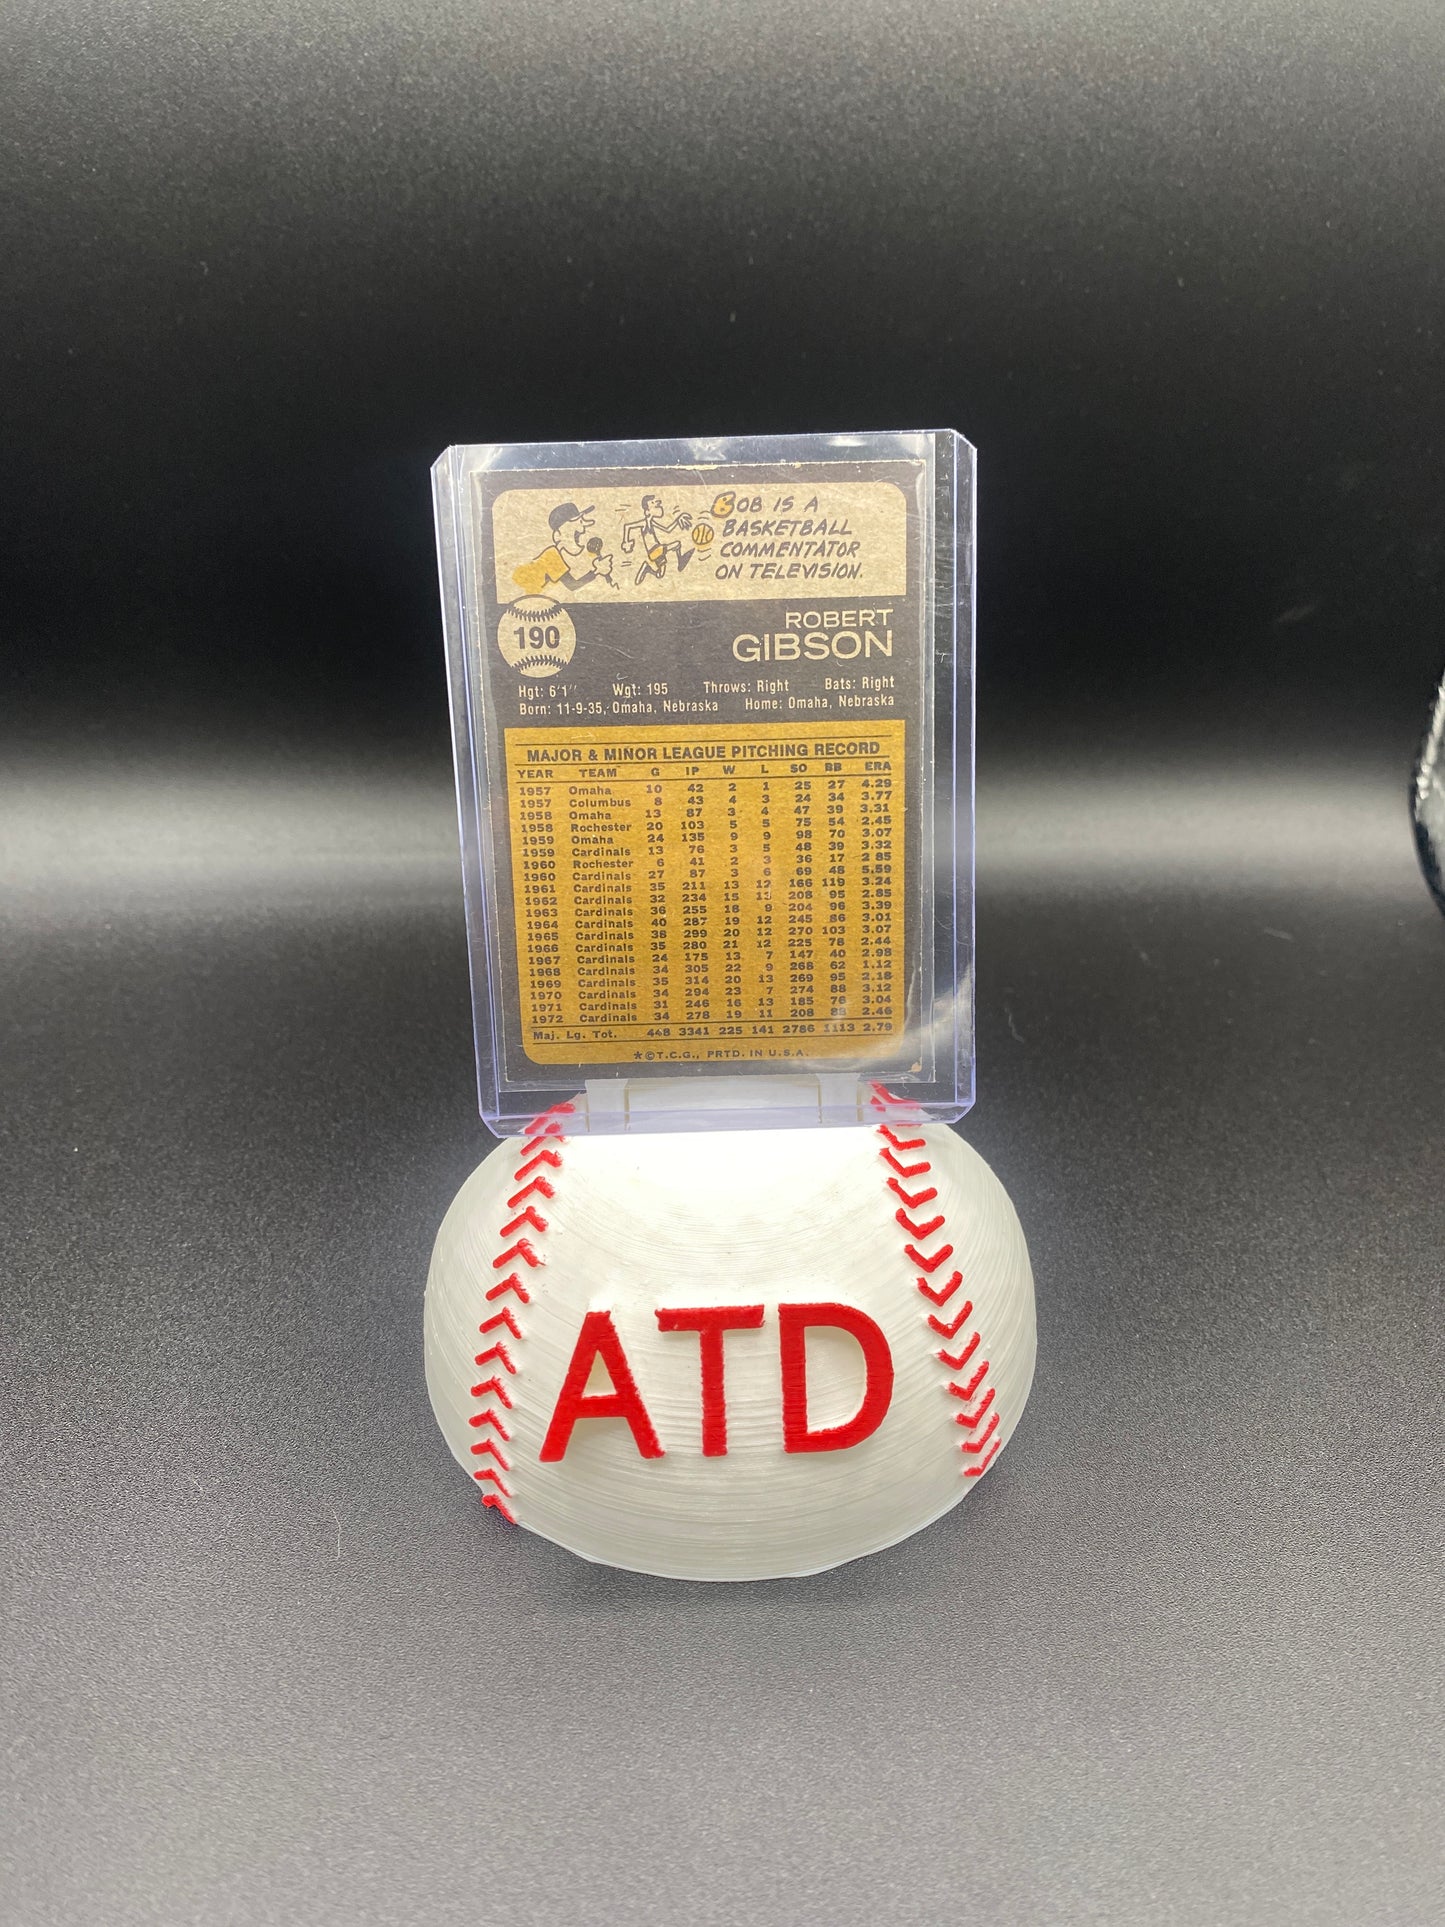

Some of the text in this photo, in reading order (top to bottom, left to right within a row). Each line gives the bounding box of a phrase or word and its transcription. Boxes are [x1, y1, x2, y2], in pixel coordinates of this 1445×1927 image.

[710, 491, 818, 518] BOB IS A
[723, 518, 852, 537] BASKETBALL
[720, 540, 860, 558] COMMENTATOR
[715, 562, 863, 580] ON TELEVISION.
[785, 608, 894, 629] ROBERT
[514, 626, 560, 650] 190
[732, 630, 893, 662] GIBSON
[519, 685, 544, 700] Hgt:
[612, 683, 641, 698] Wgt:
[647, 683, 668, 695] 195
[703, 681, 751, 693] Throws:
[757, 679, 789, 694] Right
[825, 678, 856, 690] Bats:
[862, 676, 895, 691] Right
[519, 694, 895, 715] Born: 11-9-35, Omaha, Nebraska Home: Omaha, Nebraska
[527, 742, 880, 762] MAJOR & MINOR LEAGUE PITCHING RECORD
[518, 761, 891, 778] YEAR TEAM G IP W L SO BB ERA
[519, 779, 892, 796] 1957 Omaha 42 4.29
[520, 791, 892, 808] 1957 Columbus 43 3.77
[520, 804, 889, 820] 1958 Omaha 87 3.31
[521, 816, 891, 833] 1958 Rochester 103 2.45
[522, 828, 892, 845] 1959 Omaha 135 3.07
[523, 840, 892, 857] 1959 Cardinals 76 3.32
[523, 858, 705, 869] 1960 Rochester 41
[524, 865, 892, 881] 1960 Cardinals 87 5.59
[525, 877, 892, 893] 1961 Cardinals 211 166 3.24
[525, 889, 892, 906] 1962 Cardinals 234 208 2.85
[526, 901, 892, 917] 1963 Cardinals 255 204 3.39
[527, 913, 891, 929] 1964 Cardinals 287 245 3.01
[528, 925, 891, 941] 1965 Cardinals 299 270 3.07
[528, 936, 891, 953] 1966 Cardinals 280 225 2.44
[529, 948, 892, 965] 1967 Cardinals 175 147 2.98
[530, 960, 892, 977] 1968 Cardinals 305 268 1.12
[530, 972, 892, 989] 1969 Cardinals 314 269 2.18
[531, 984, 892, 1000] 1970 Cardinals 294 274 3.12
[532, 995, 891, 1012] 1971 Cardinals 246 185 3.04
[532, 1007, 892, 1024] 1972 Cardinals 278 208 2.46
[533, 1022, 892, 1040] Maj. Lg. Tot. 448 3341 225 141 2786 1113 2.79
[707, 1050, 745, 1059] PRTD.
[750, 1050, 763, 1058] IN
[769, 1049, 809, 1058] U.S.A.
[538, 1302, 895, 1463] ATD
